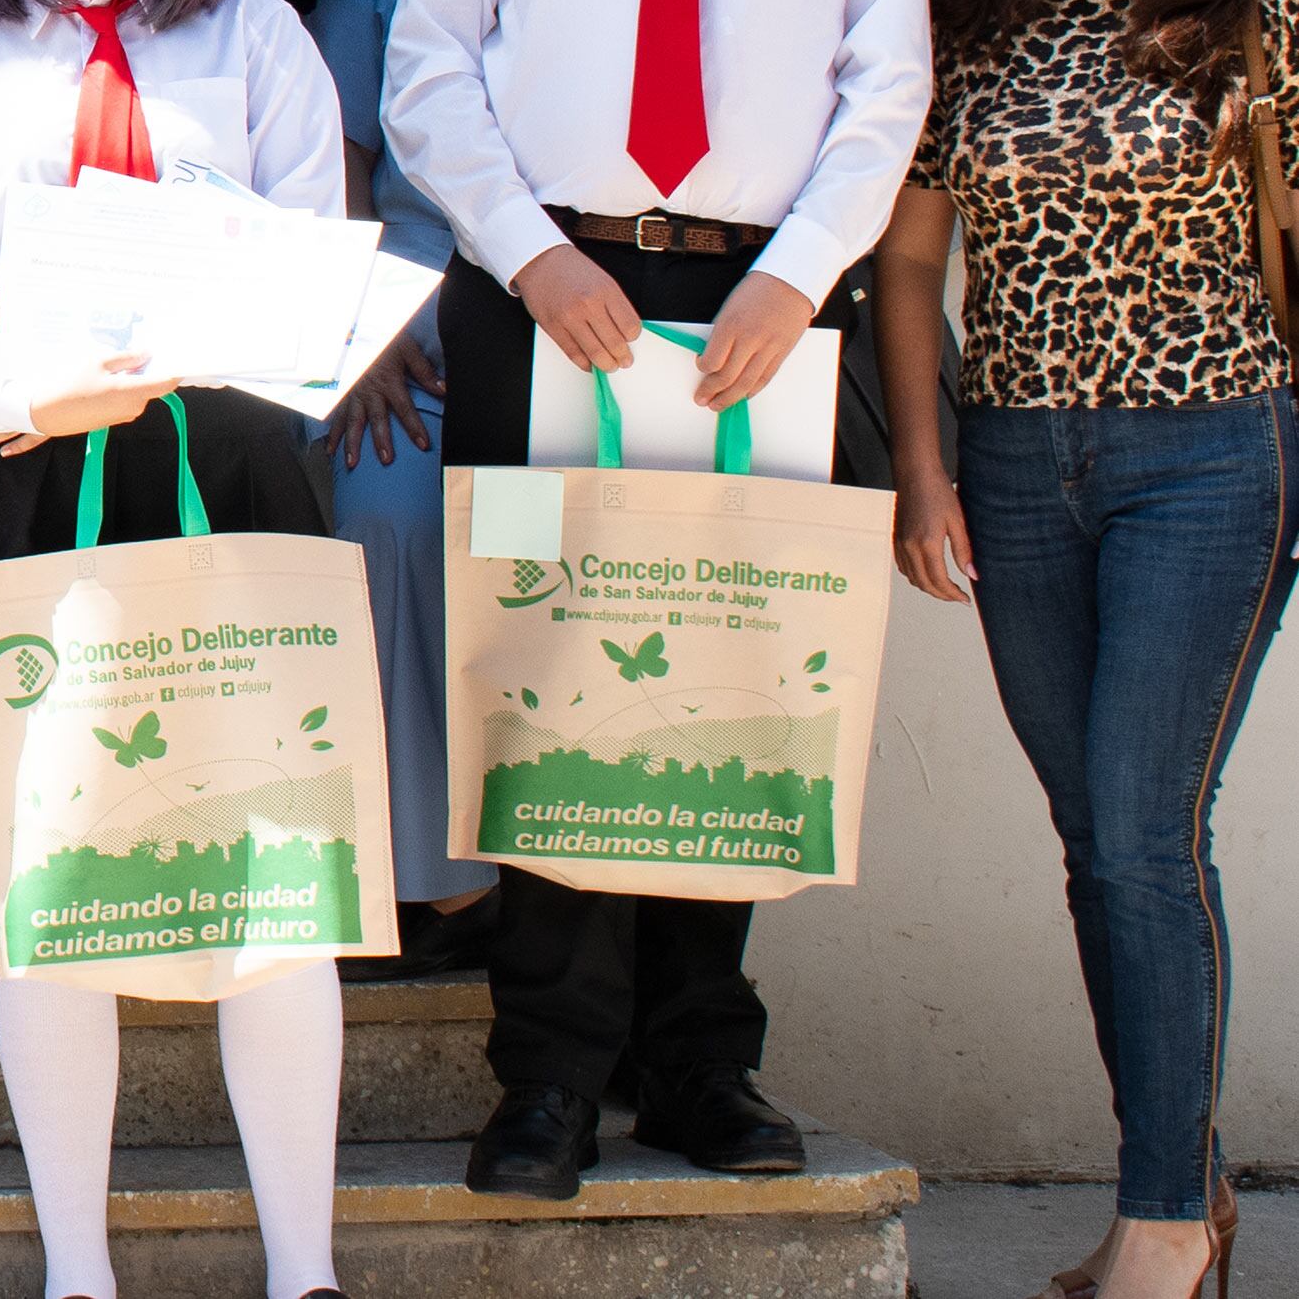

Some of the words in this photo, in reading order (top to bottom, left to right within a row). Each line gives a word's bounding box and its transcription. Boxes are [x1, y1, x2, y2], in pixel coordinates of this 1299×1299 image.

[579, 552, 687, 586] Concejo
[695, 556, 849, 595] Deliberante
[579, 583, 599, 599] de
[602, 583, 633, 601] San
[635, 585, 701, 602] Salvador
[706, 588, 725, 603] de
[728, 587, 768, 610] Jujuy
[683, 612, 722, 628] cdjujuy
[743, 616, 781, 632] cdjujuy
[66, 631, 173, 666] Concejo
[181, 622, 338, 653] Deliberante
[66, 672, 84, 687] de
[88, 668, 117, 685] San
[122, 659, 194, 682] Salvador
[197, 658, 215, 673] de
[219, 653, 256, 672] Jujuy
[177, 683, 216, 701] cdjujuy
[237, 679, 272, 695] cdjujuy
[513, 799, 662, 826] cuidando
[667, 803, 696, 828] la
[701, 806, 805, 836] ciudad
[514, 829, 669, 856] cuidamos
[675, 834, 707, 858] el
[708, 836, 802, 864] futuro
[30, 891, 183, 930] cuidando
[188, 887, 216, 912] la
[221, 881, 318, 910] ciudad
[34, 922, 194, 959] cuidamos
[200, 919, 230, 942] el
[232, 916, 318, 941] futuro
